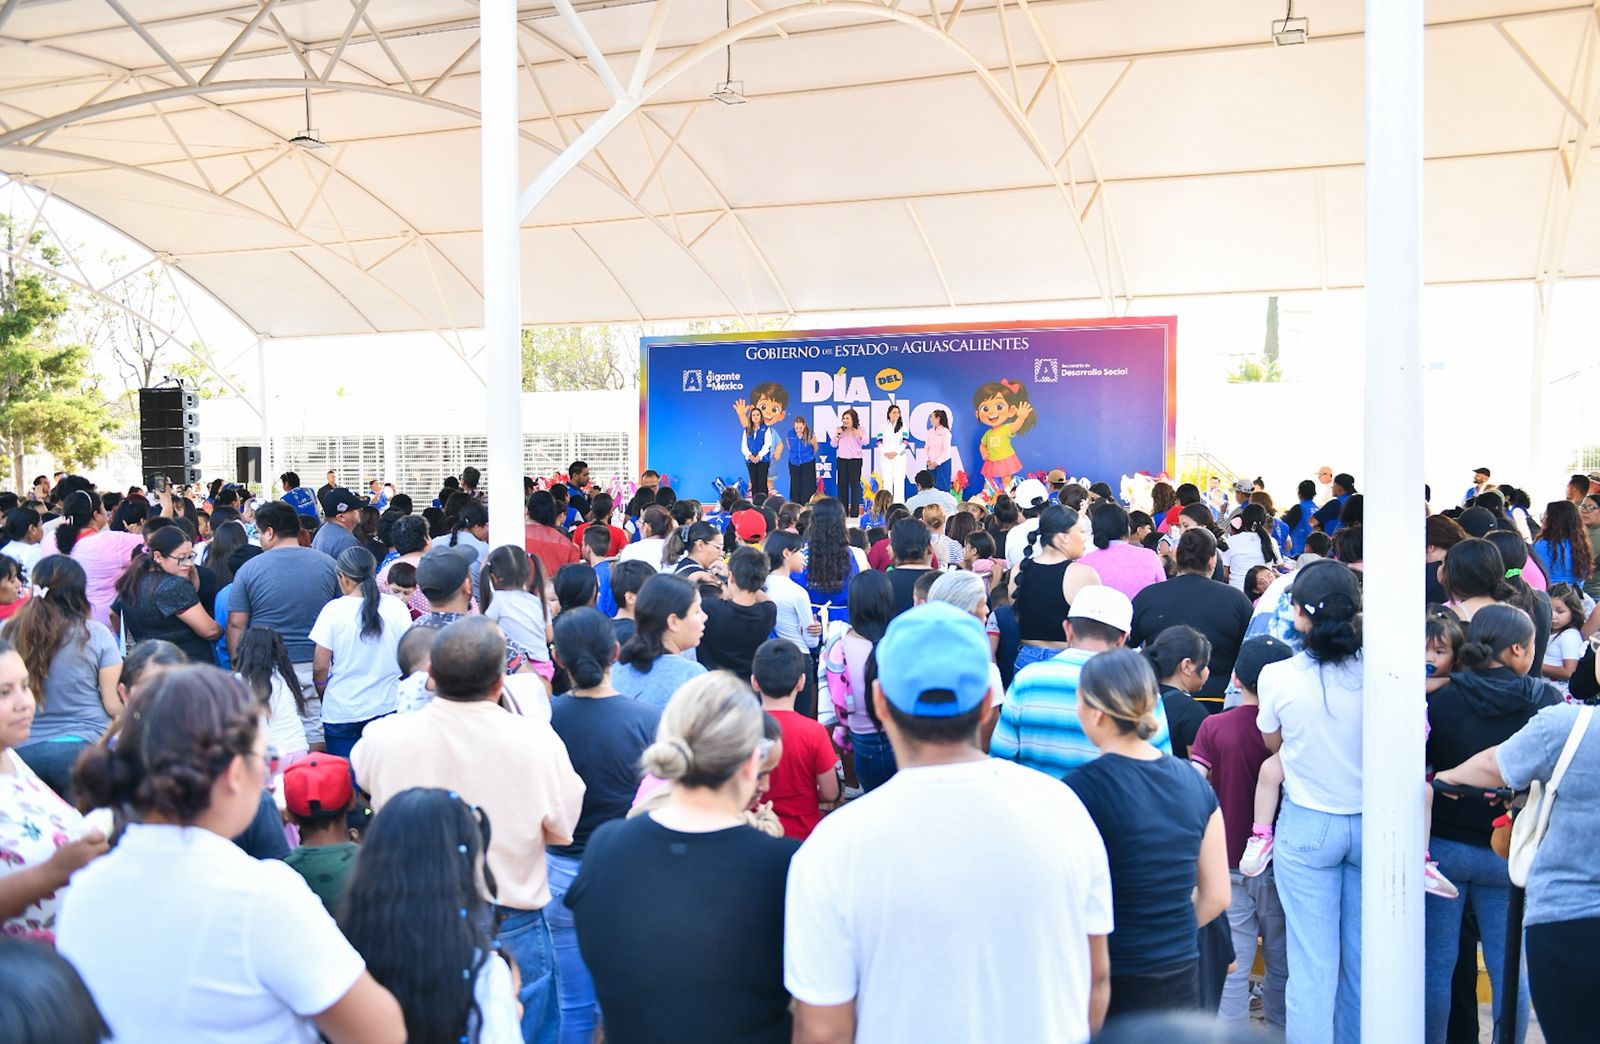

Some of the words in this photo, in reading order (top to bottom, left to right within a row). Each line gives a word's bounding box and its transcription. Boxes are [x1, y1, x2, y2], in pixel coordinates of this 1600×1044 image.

[745, 346, 820, 360] GOBIERNO
[834, 342, 889, 357] ESTADO
[900, 337, 1030, 353] AGUASCALIENTES
[1061, 368, 1103, 377] Desarrollo
[1103, 367, 1129, 376] Social
[801, 366, 872, 403] DÍA
[877, 374, 902, 386] DEL
[819, 455, 828, 463] Y
[816, 463, 832, 471] DE
